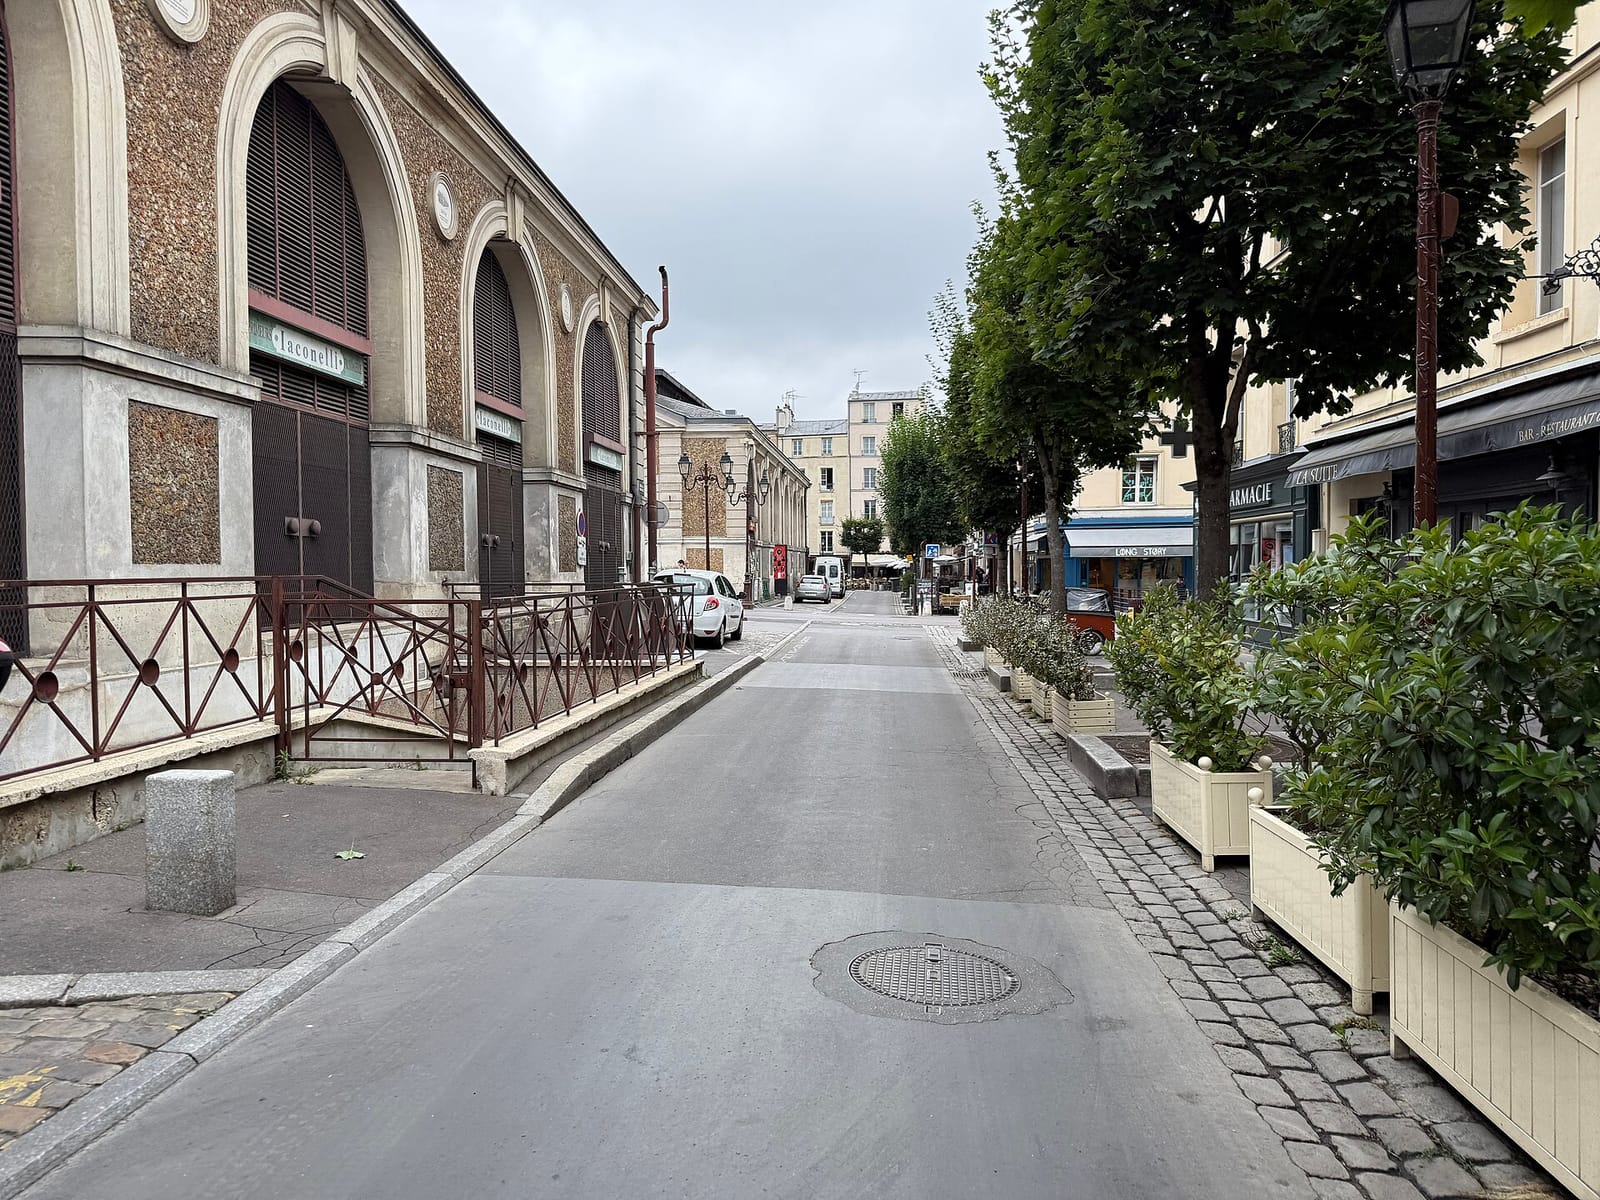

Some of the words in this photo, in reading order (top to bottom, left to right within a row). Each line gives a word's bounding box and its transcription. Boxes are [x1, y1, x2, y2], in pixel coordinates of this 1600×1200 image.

[1518, 428, 1535, 442] BAR
[1540, 411, 1597, 437] RESTAURANT
[1296, 469, 1309, 485] LA
[1310, 463, 1338, 482] SUITE
[1229, 482, 1273, 507] ARMACIE
[1115, 547, 1138, 556] LONG
